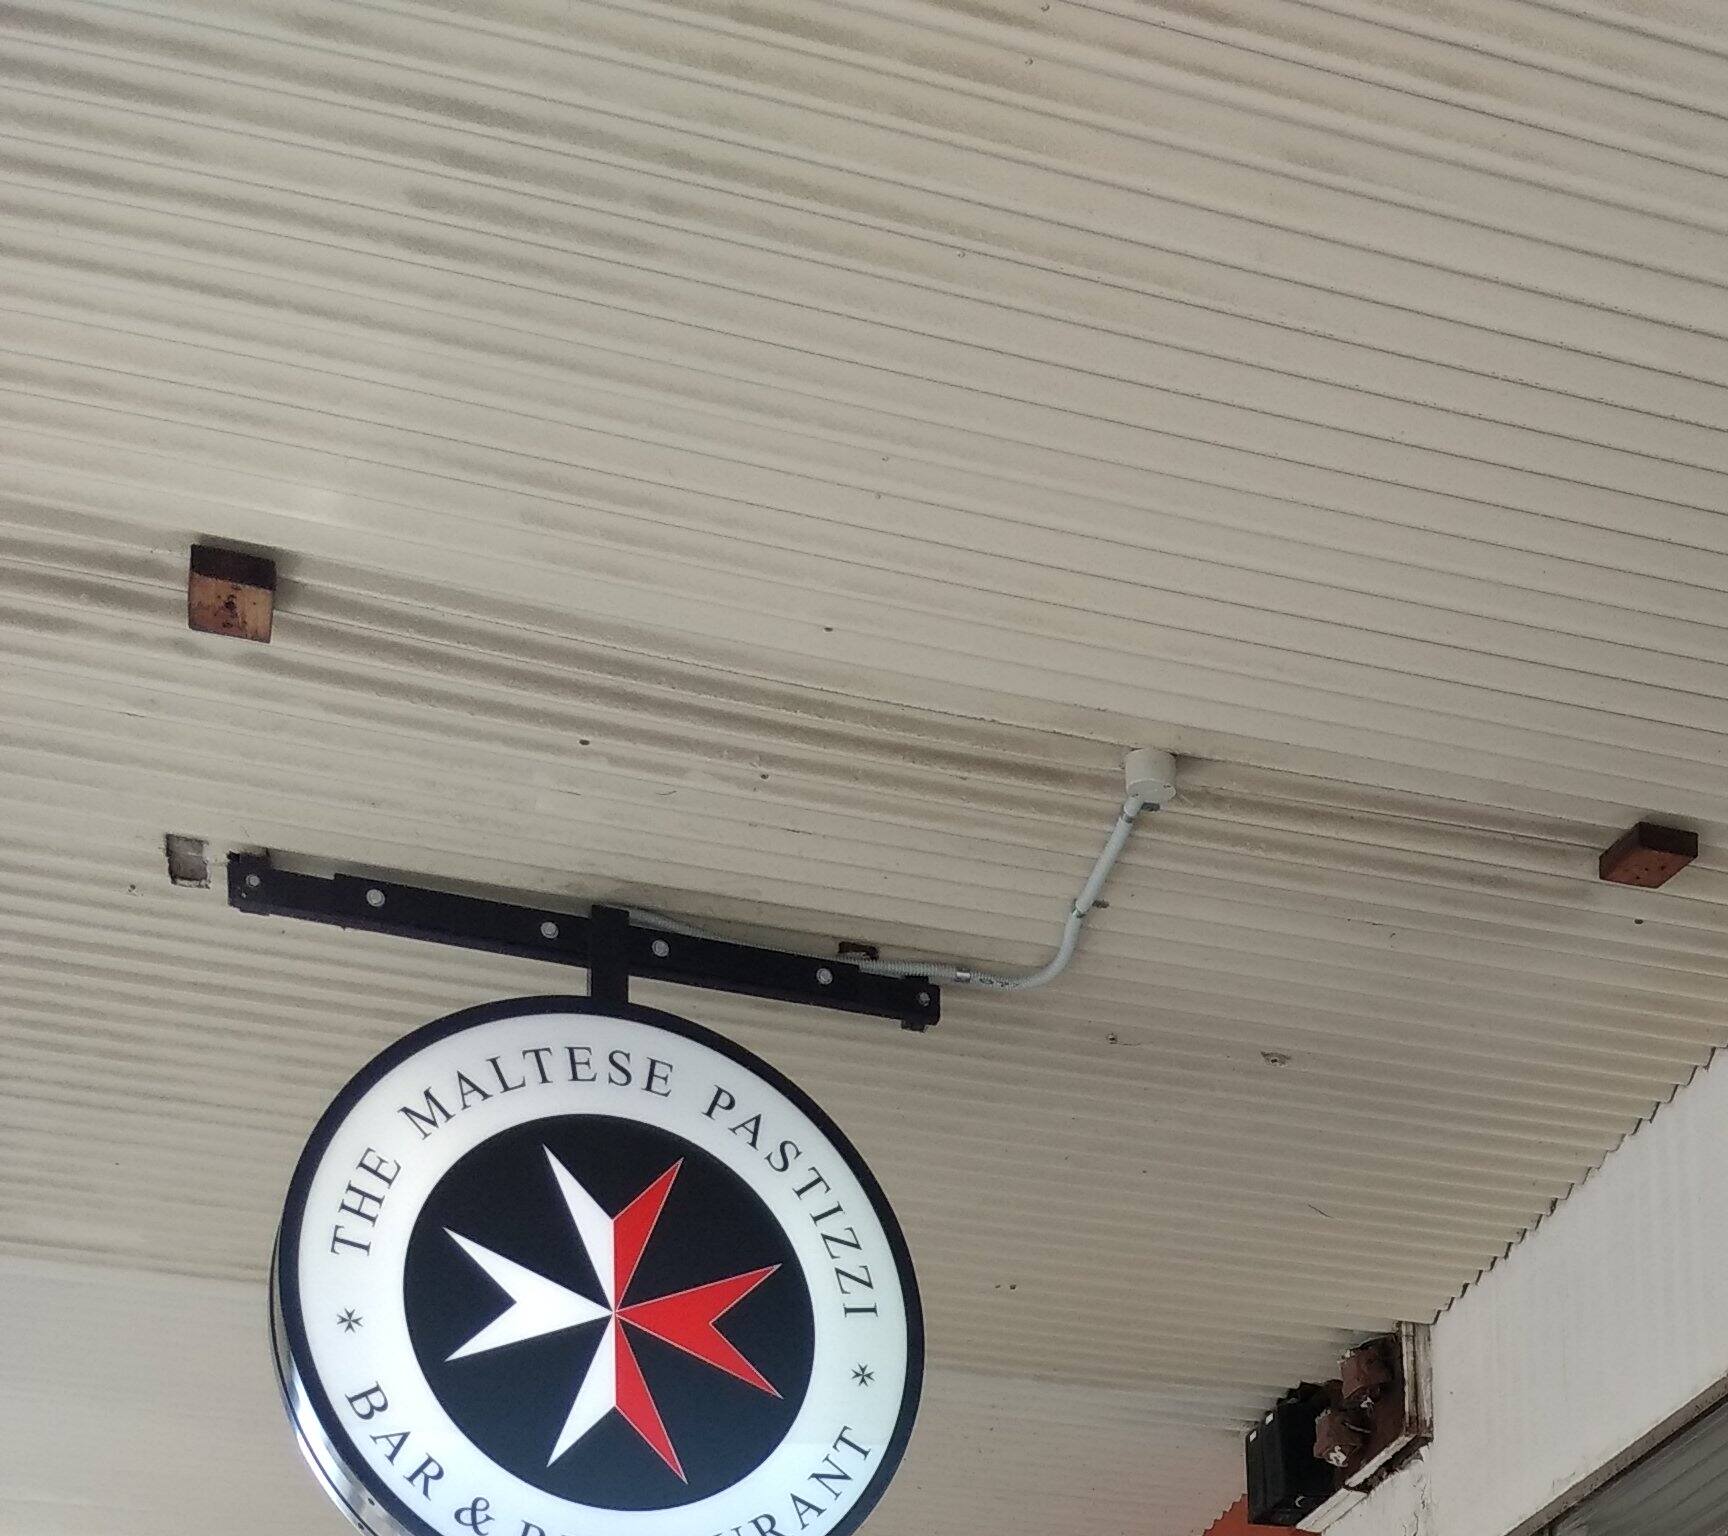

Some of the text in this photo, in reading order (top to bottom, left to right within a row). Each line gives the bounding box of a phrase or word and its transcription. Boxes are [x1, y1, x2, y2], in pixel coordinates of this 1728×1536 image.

[332, 1045, 878, 1319] THE MALTESE PASTIZZI
[346, 1382, 444, 1501] BAR
